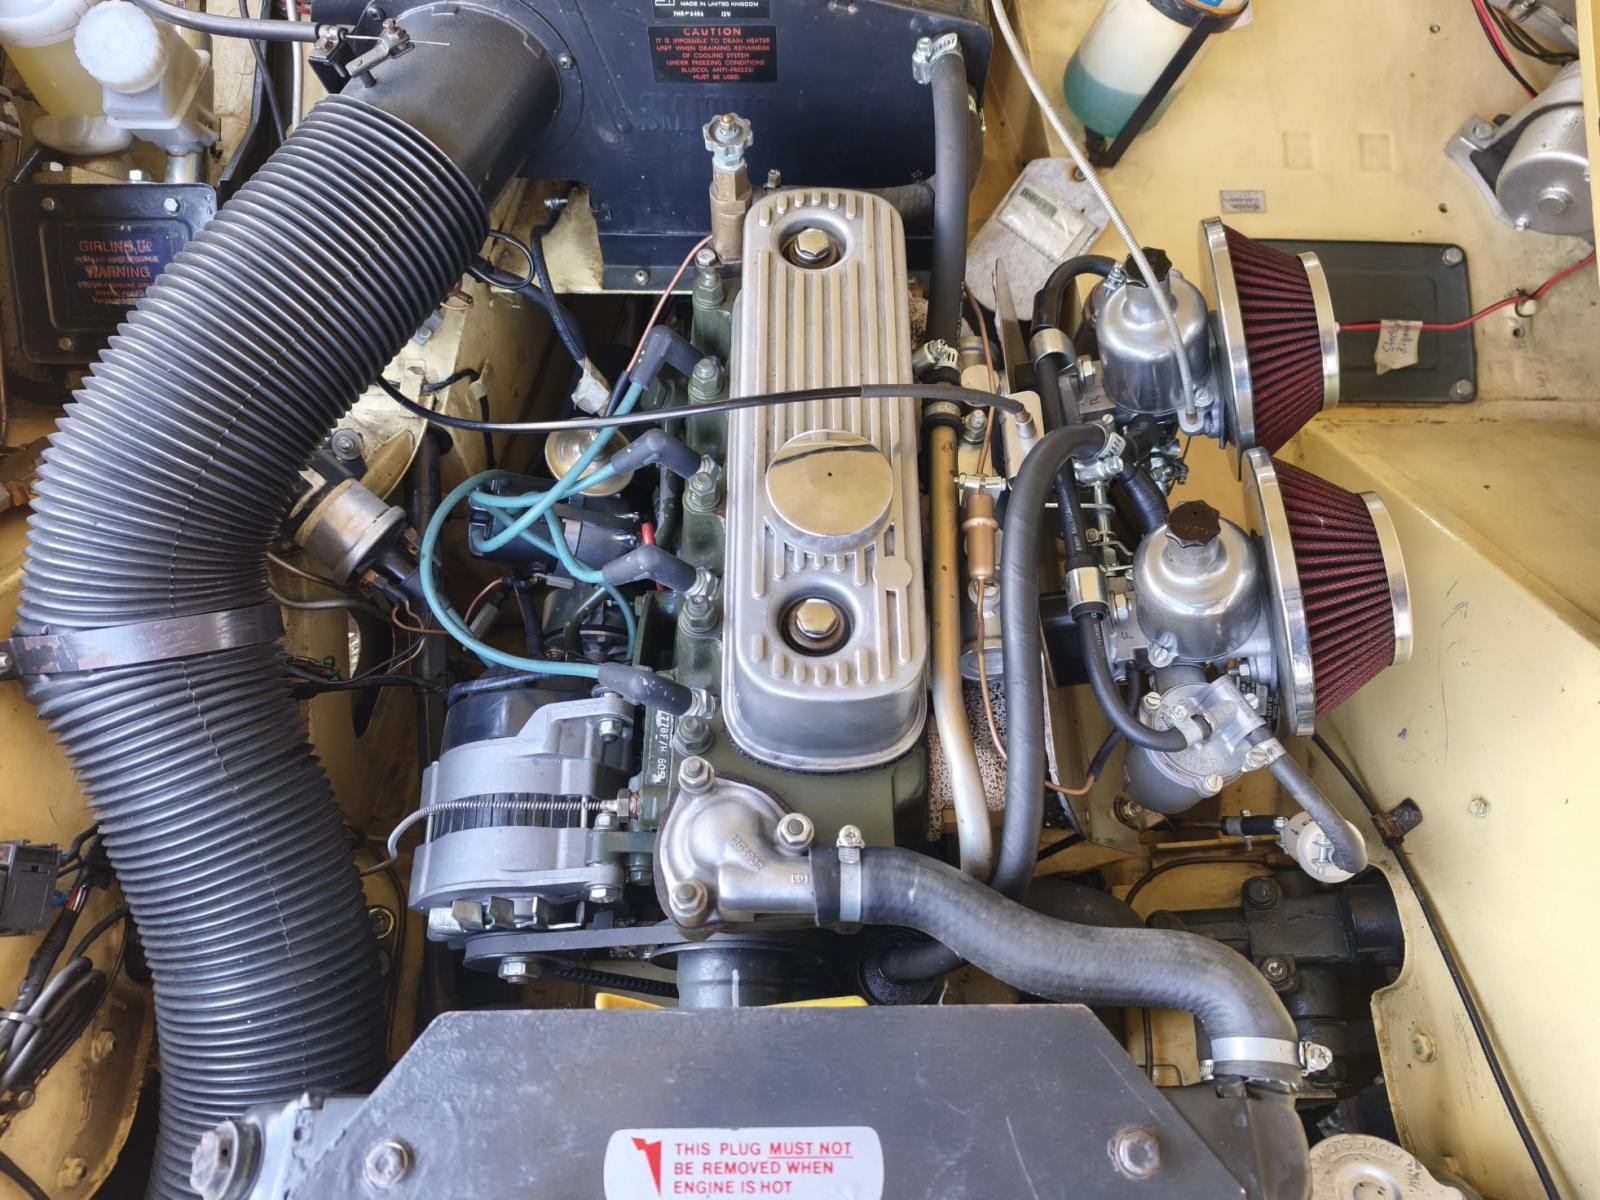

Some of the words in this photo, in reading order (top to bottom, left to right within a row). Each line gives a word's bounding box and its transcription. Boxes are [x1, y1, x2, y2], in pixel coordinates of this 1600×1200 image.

[683, 27, 742, 36] CAUTION
[79, 239, 134, 253] GIRLING
[84, 266, 151, 278] WARNING
[731, 834, 764, 874] 12G1902
[674, 1142, 711, 1156] THIS
[719, 1142, 761, 1156] PLUG
[769, 1141, 813, 1155] MUST
[819, 1141, 852, 1155] NOT
[673, 1161, 694, 1175] BE
[702, 1161, 781, 1175] REMOVED
[786, 1161, 834, 1174] WHEN
[673, 1181, 735, 1194] ENGINE
[740, 1181, 756, 1194] IS
[760, 1181, 793, 1194] HOT
